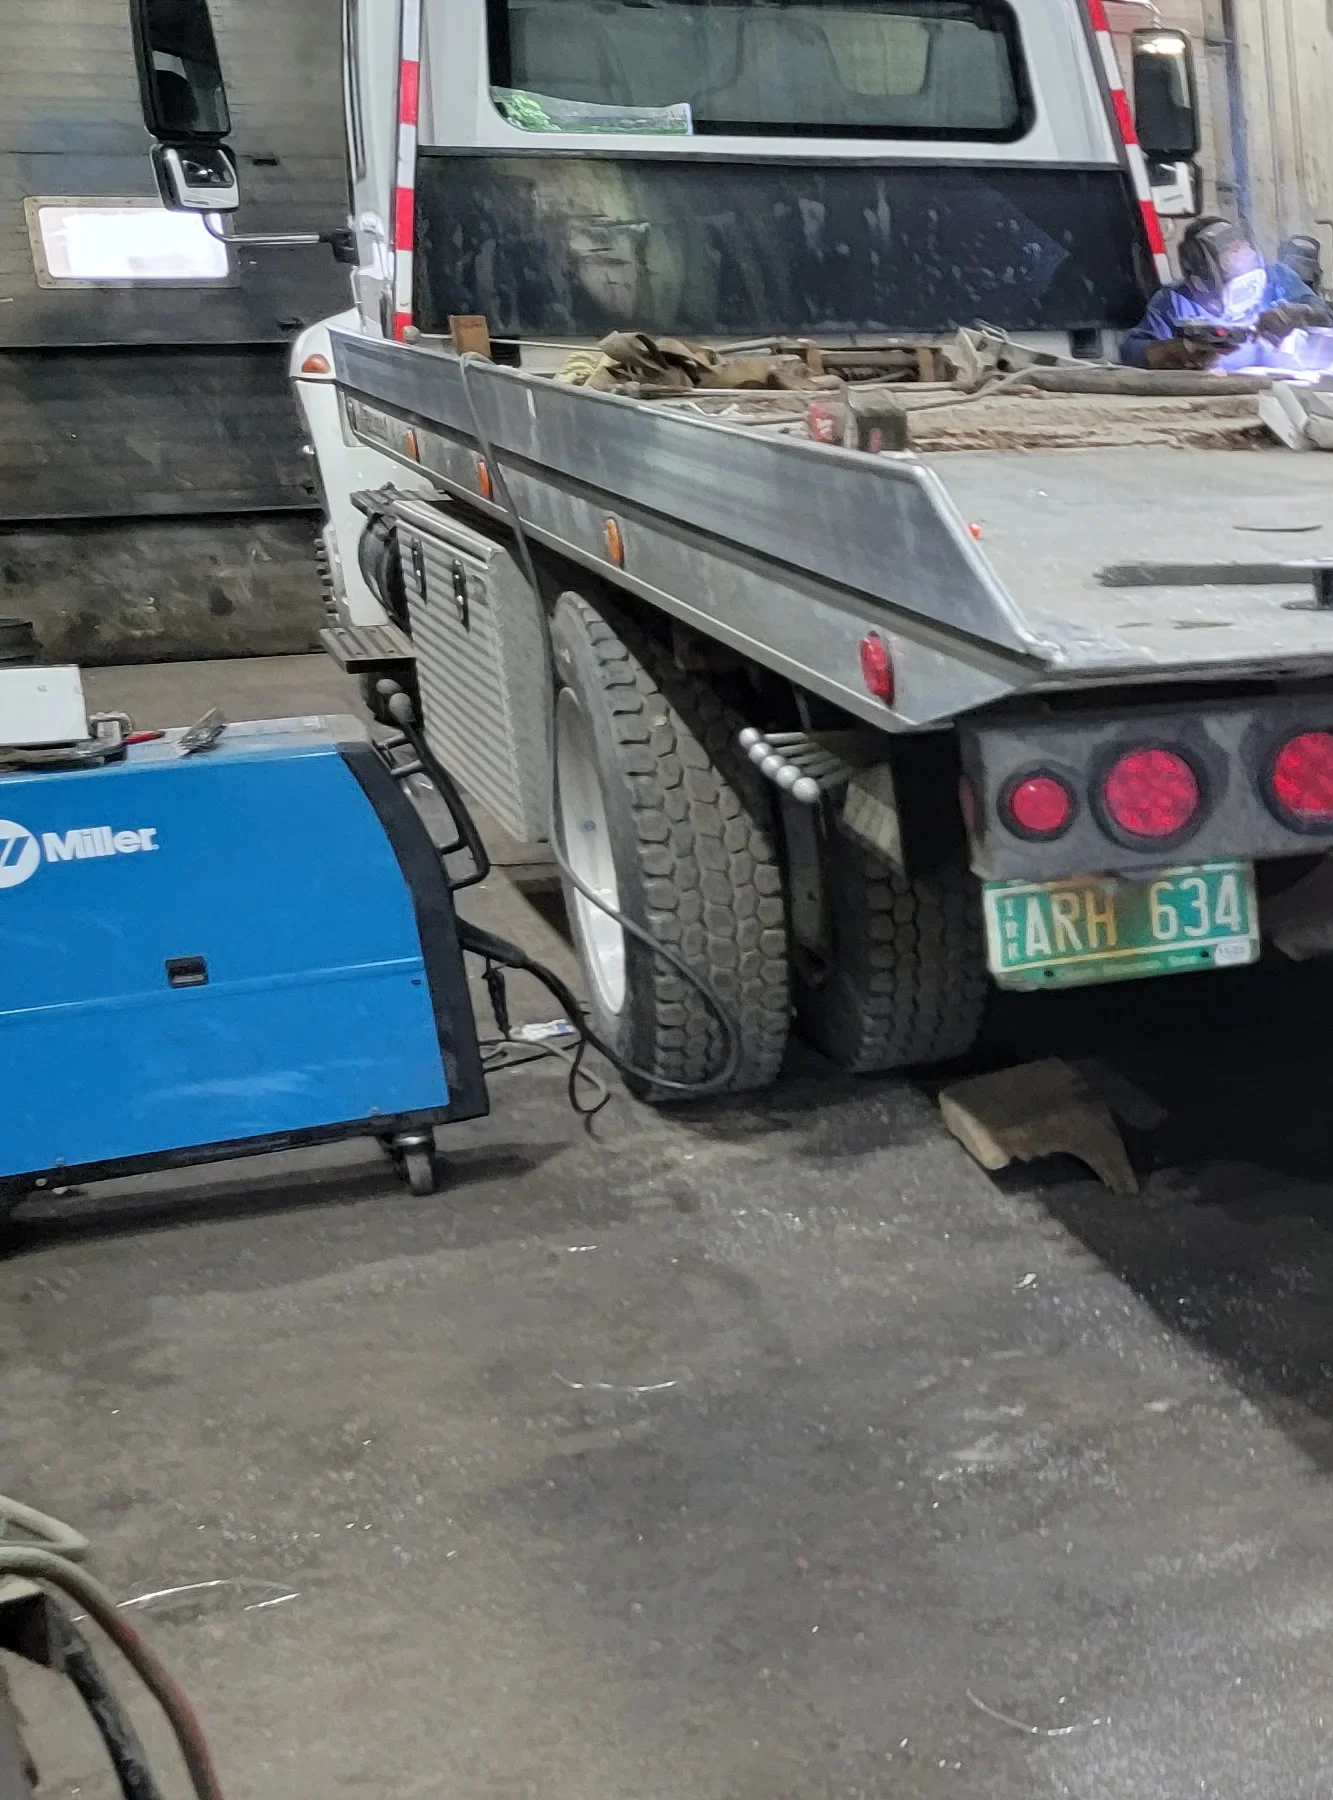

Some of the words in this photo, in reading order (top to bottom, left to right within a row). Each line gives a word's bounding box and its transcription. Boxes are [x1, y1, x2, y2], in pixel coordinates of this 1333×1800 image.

[42, 825, 160, 863] Miller
[1025, 887, 1118, 957] ARH
[1149, 873, 1243, 940] 634
